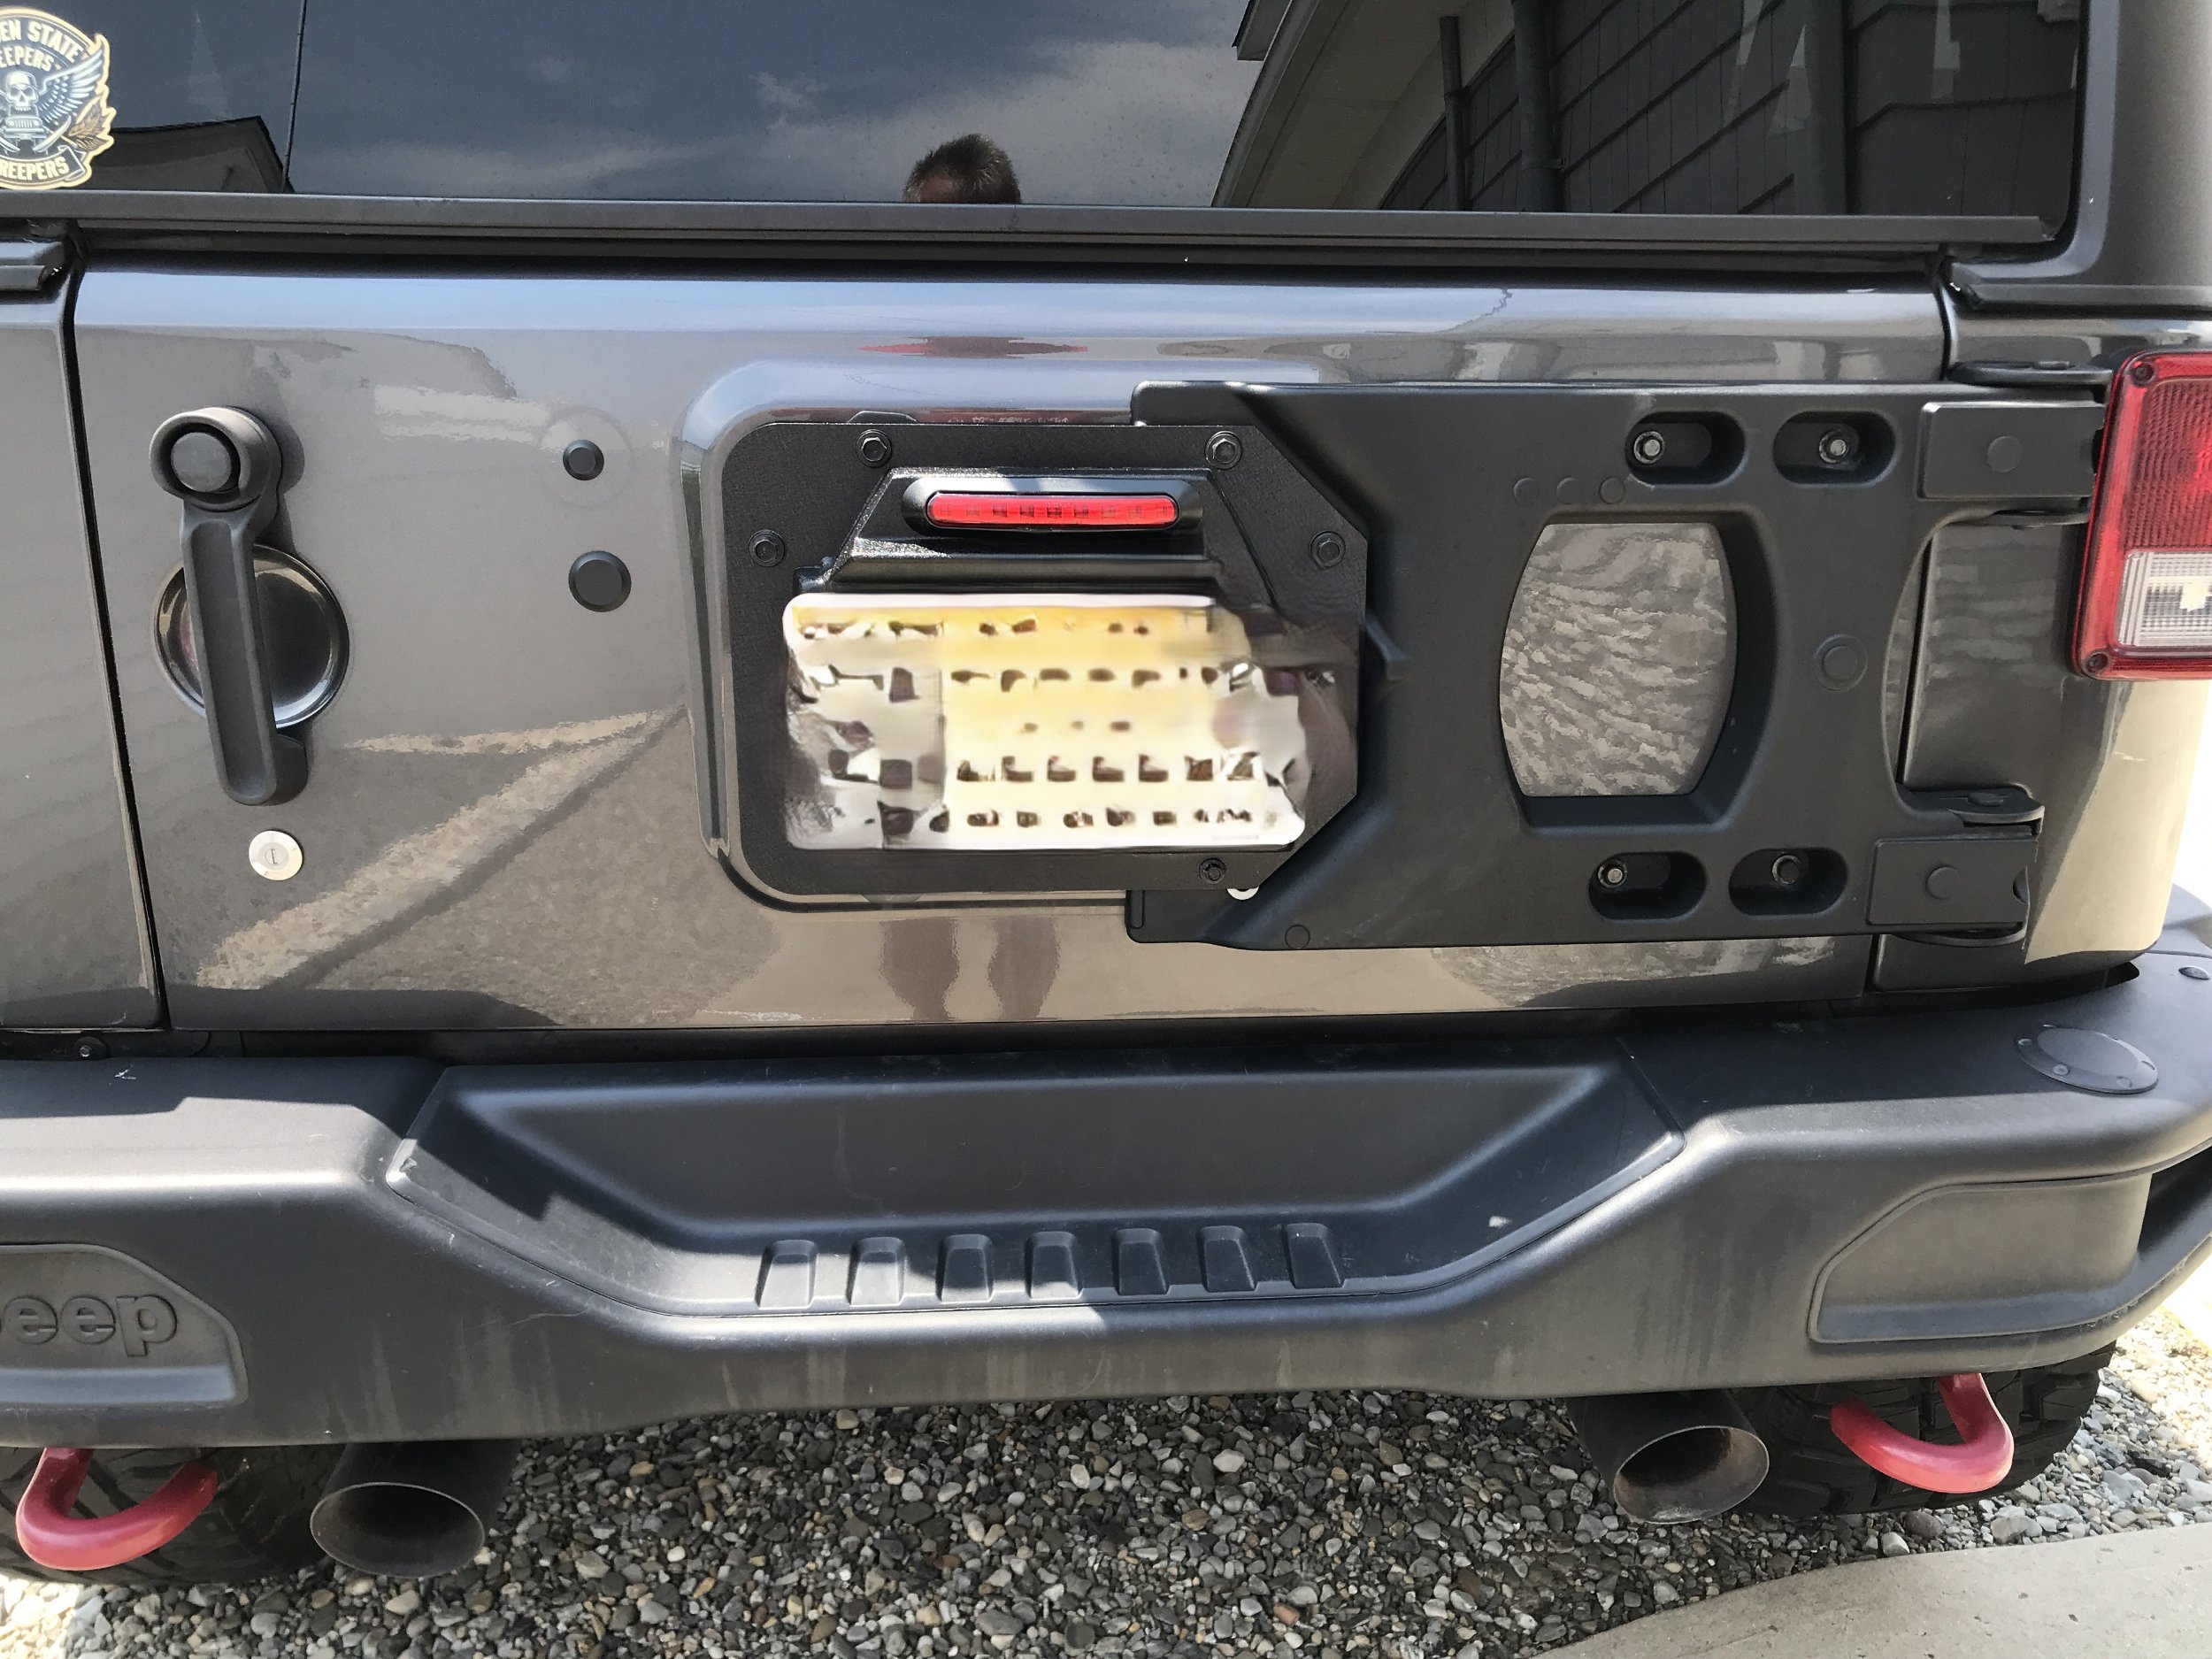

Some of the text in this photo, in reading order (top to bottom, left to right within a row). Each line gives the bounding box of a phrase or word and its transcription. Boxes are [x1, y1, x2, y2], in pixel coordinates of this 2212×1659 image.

[27, 20, 84, 63] STATE
[0, 156, 70, 180] REEPERS
[3, 1294, 177, 1357] eep
